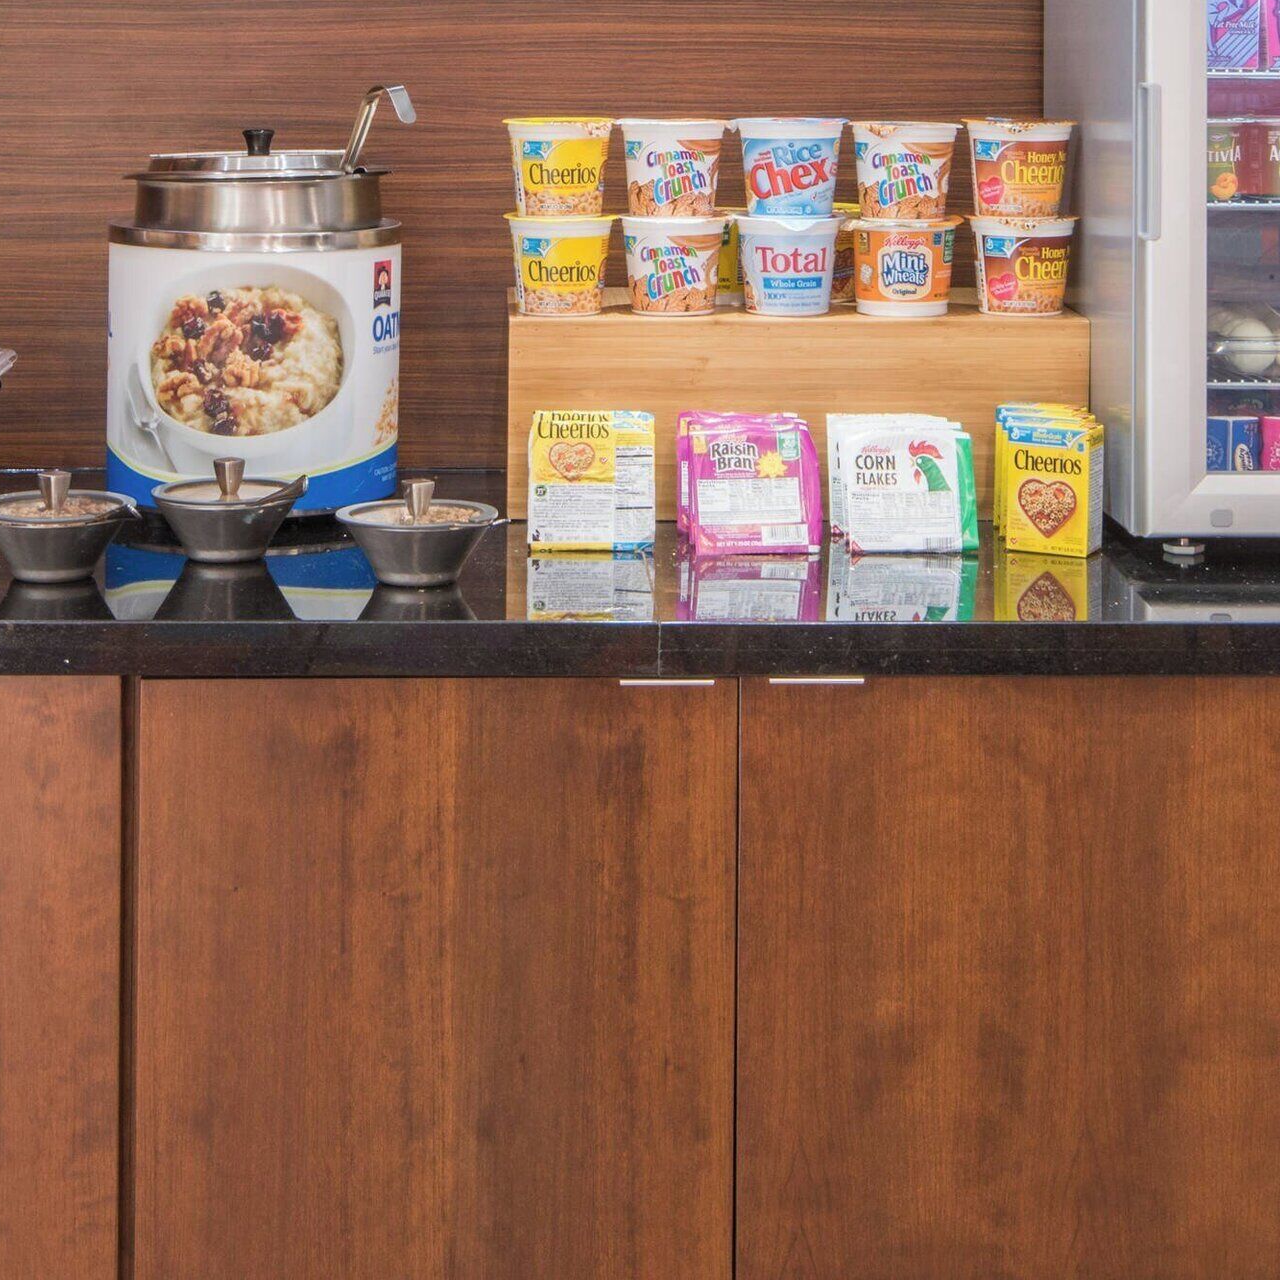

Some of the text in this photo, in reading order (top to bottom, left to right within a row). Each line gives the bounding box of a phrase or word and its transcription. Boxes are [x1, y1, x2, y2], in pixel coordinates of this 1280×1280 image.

[647, 149, 705, 168] Cinnamon
[771, 142, 822, 168] Rice
[872, 152, 931, 169] Cinnamon
[1027, 151, 1056, 165] Honey
[529, 162, 596, 185] Cheerios
[662, 161, 696, 179] Toast
[750, 158, 830, 200] Chex
[886, 163, 920, 182] Toast
[653, 170, 707, 206] Crunch
[878, 172, 933, 208] Crunch
[640, 245, 697, 262] Cinnamon
[754, 246, 827, 274] Total
[1041, 247, 1067, 261] Honey
[528, 259, 596, 283] Cheerios
[653, 256, 687, 274] Toast
[647, 267, 701, 301] Crunch
[770, 279, 818, 289] Whole Grain
[882, 269, 926, 287] Wheats
[892, 288, 918, 296] Original
[711, 442, 757, 458] Raisin
[717, 457, 753, 470] Bran
[855, 455, 896, 471] CORN
[1014, 448, 1082, 476] Cheerios
[856, 472, 898, 486] FLAKES
